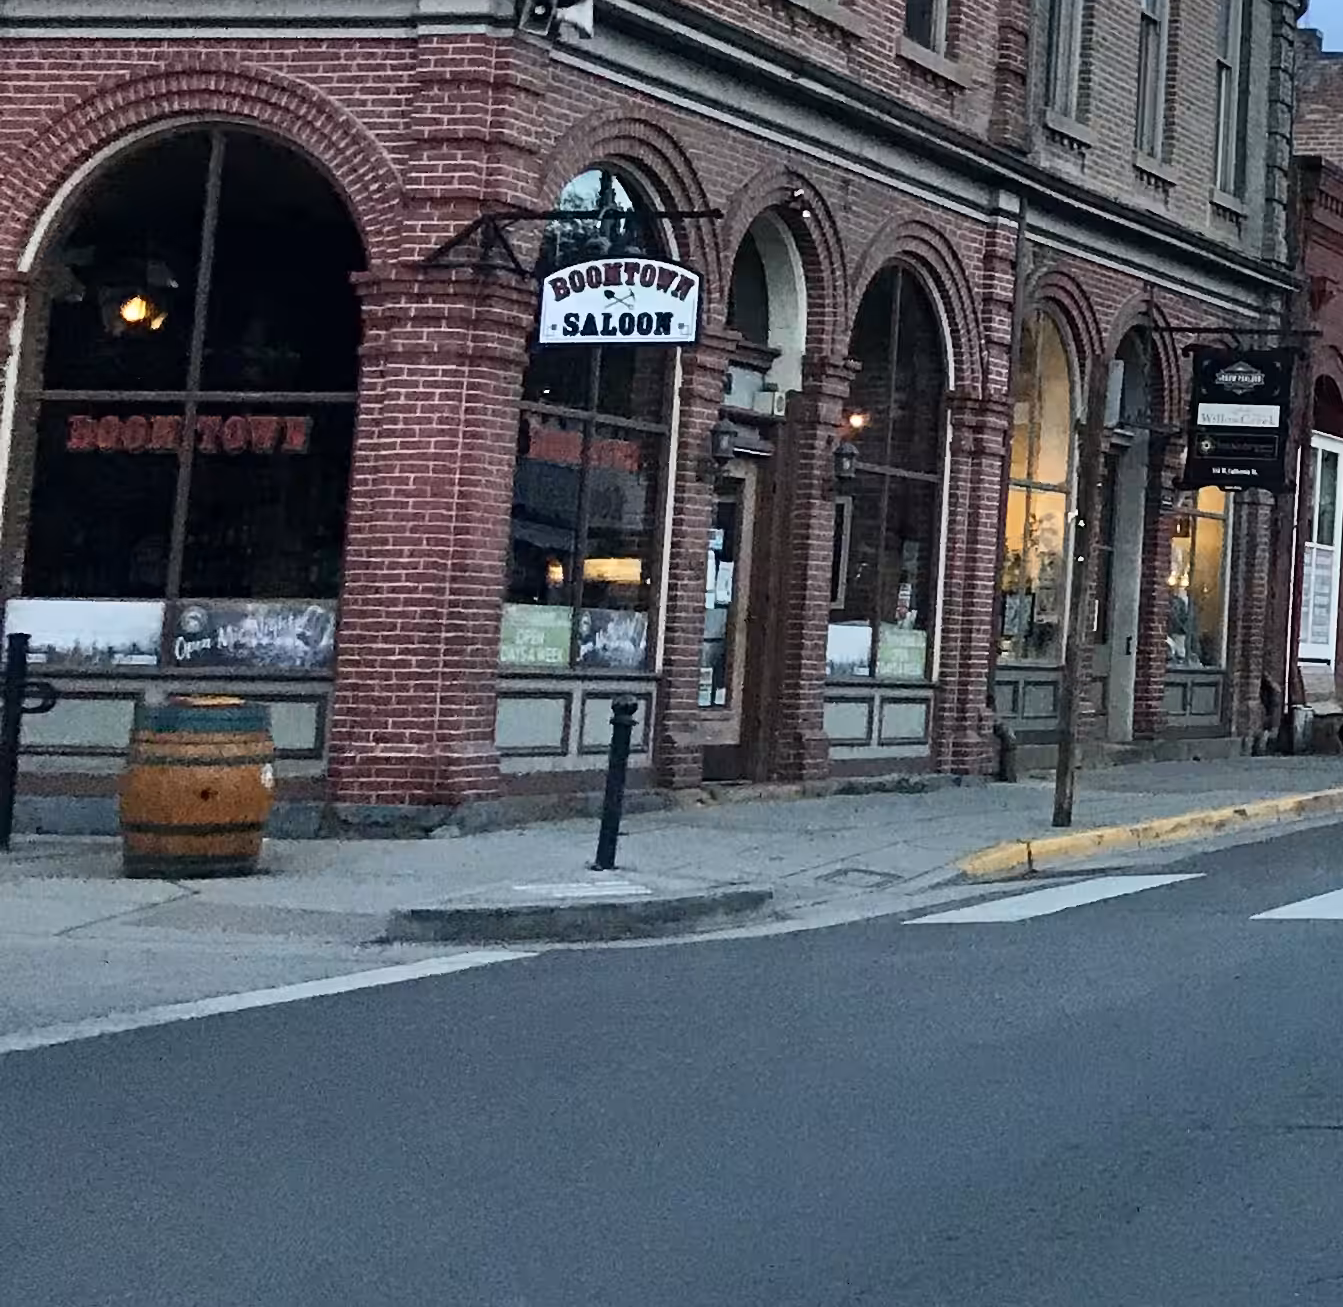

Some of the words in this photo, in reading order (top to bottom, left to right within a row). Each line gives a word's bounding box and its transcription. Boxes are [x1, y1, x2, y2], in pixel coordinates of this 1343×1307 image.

[549, 262, 695, 302] BOOMTOWN
[562, 311, 674, 337] SALOON
[66, 415, 313, 454] BOOMTOWN
